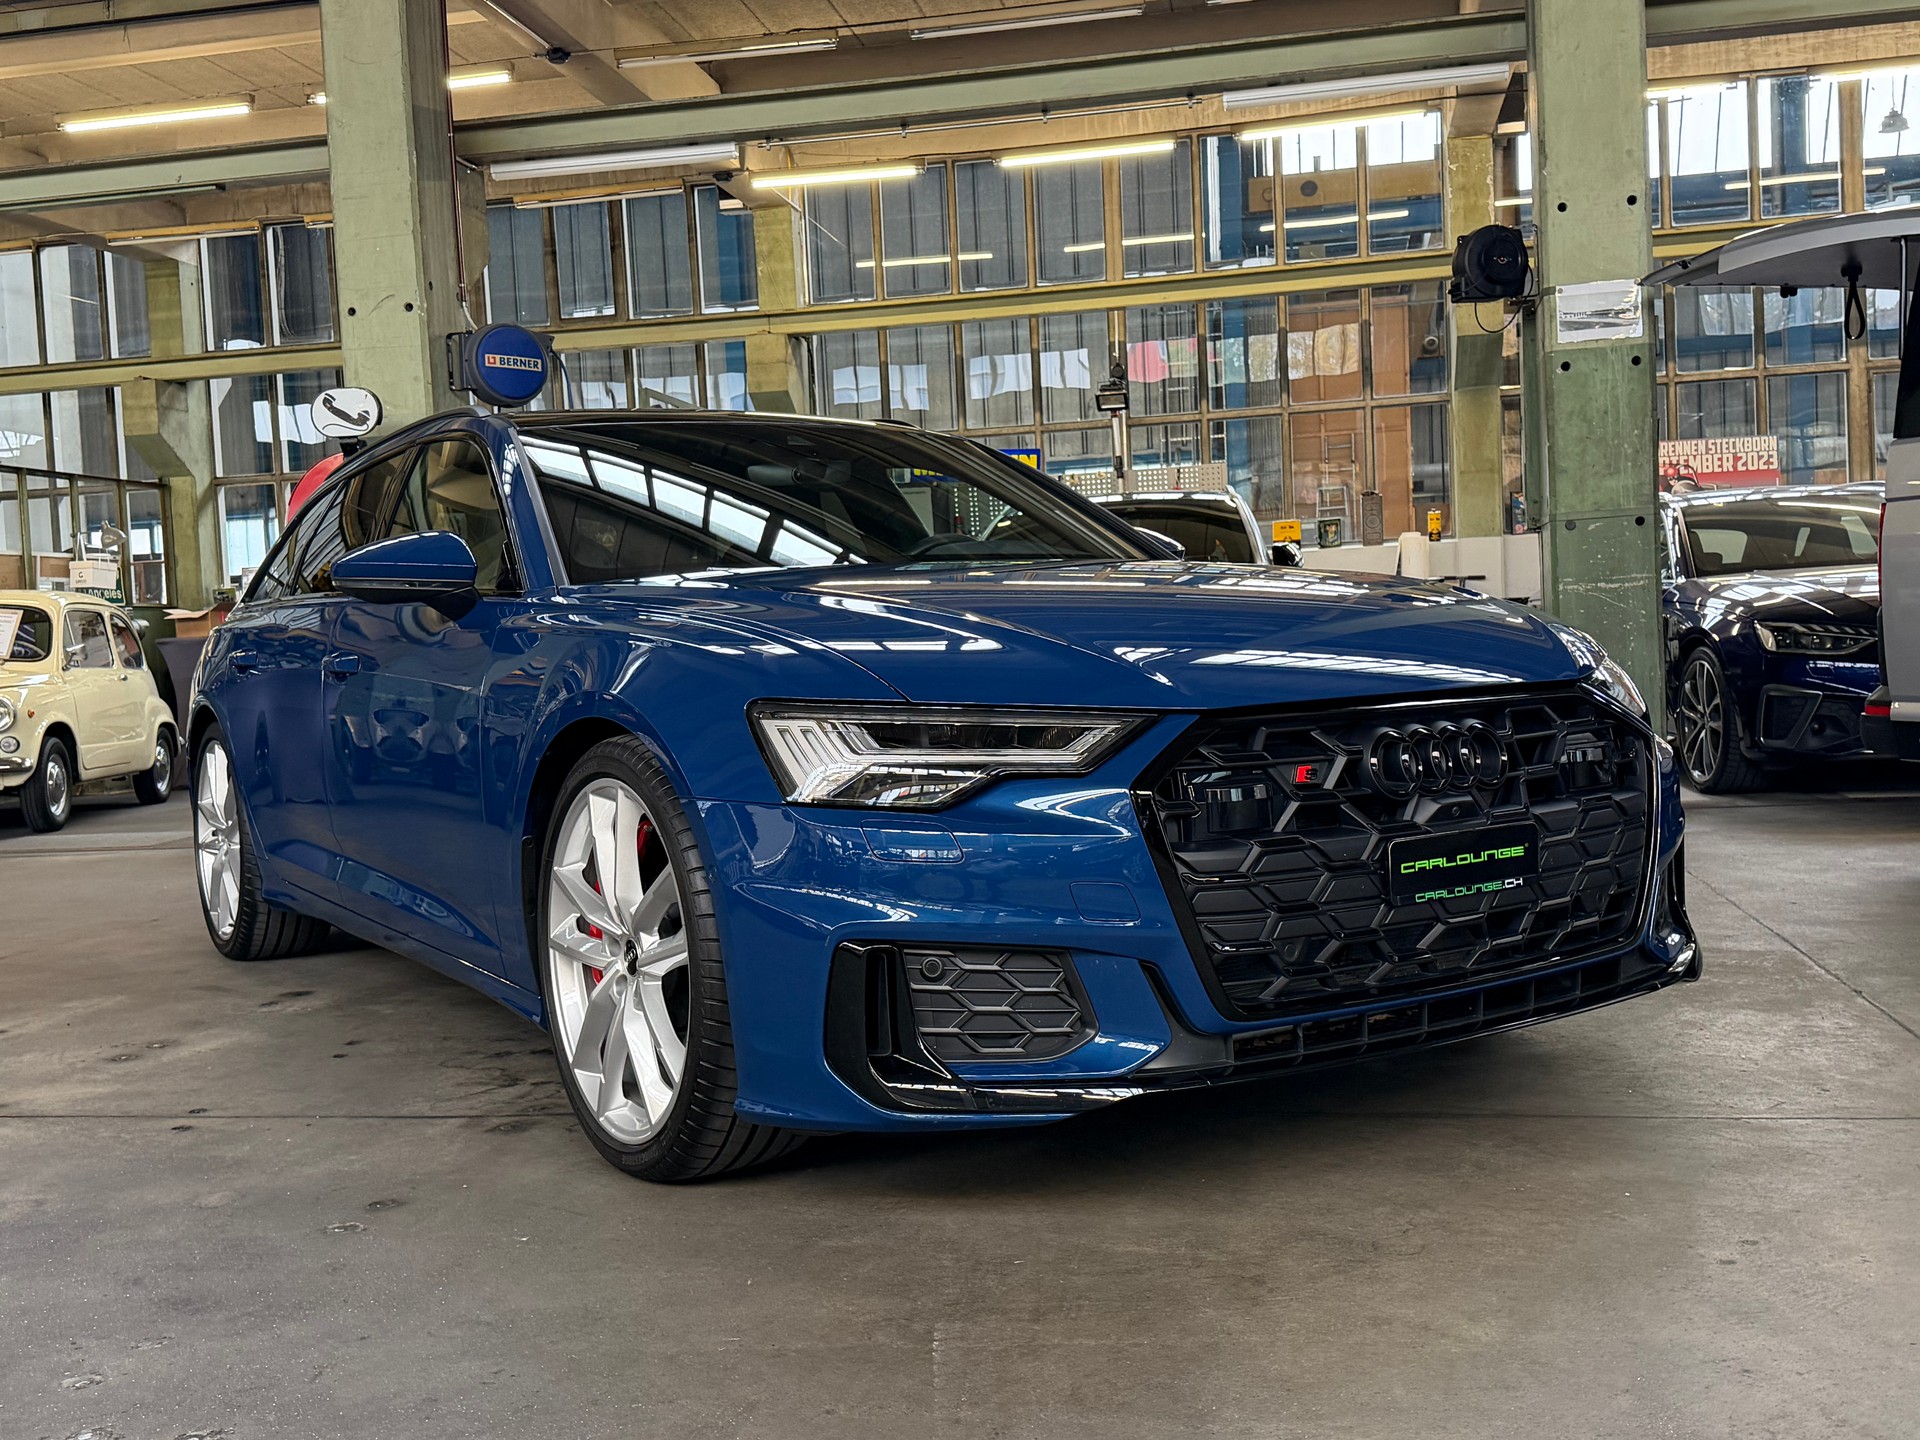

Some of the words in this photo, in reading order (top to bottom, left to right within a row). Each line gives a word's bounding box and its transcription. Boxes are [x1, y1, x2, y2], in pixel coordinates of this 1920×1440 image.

[499, 356, 540, 370] BERNER
[1659, 439, 1706, 457] RENNEN
[1708, 435, 1778, 455] STECKBORN
[1659, 453, 1734, 476] PTEMBER
[1737, 450, 1779, 471] 2023
[1400, 845, 1525, 874] CARLOUNGE
[1414, 877, 1524, 903] CARLOUNGE.CH
